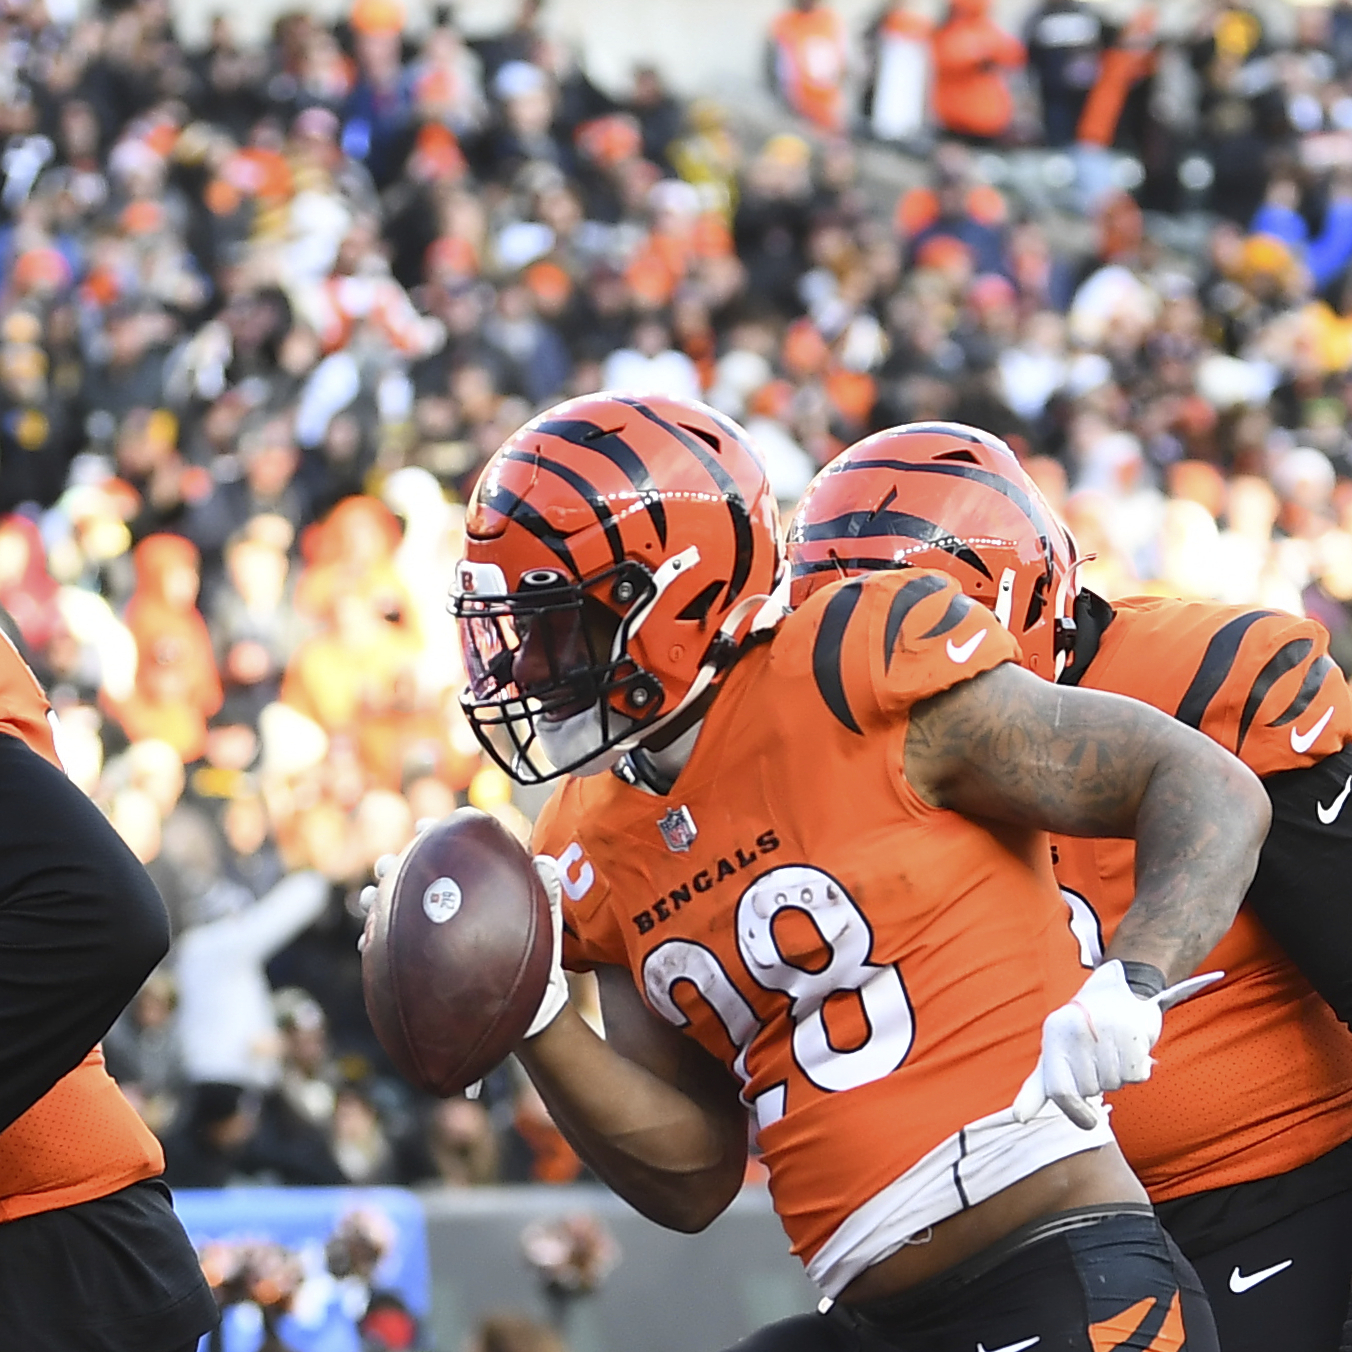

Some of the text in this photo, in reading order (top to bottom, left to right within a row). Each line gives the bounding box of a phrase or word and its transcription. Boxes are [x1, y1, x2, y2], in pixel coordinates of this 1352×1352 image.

[557, 842, 594, 901] C
[632, 829, 780, 935] BENGALS
[641, 863, 916, 1131] 28
